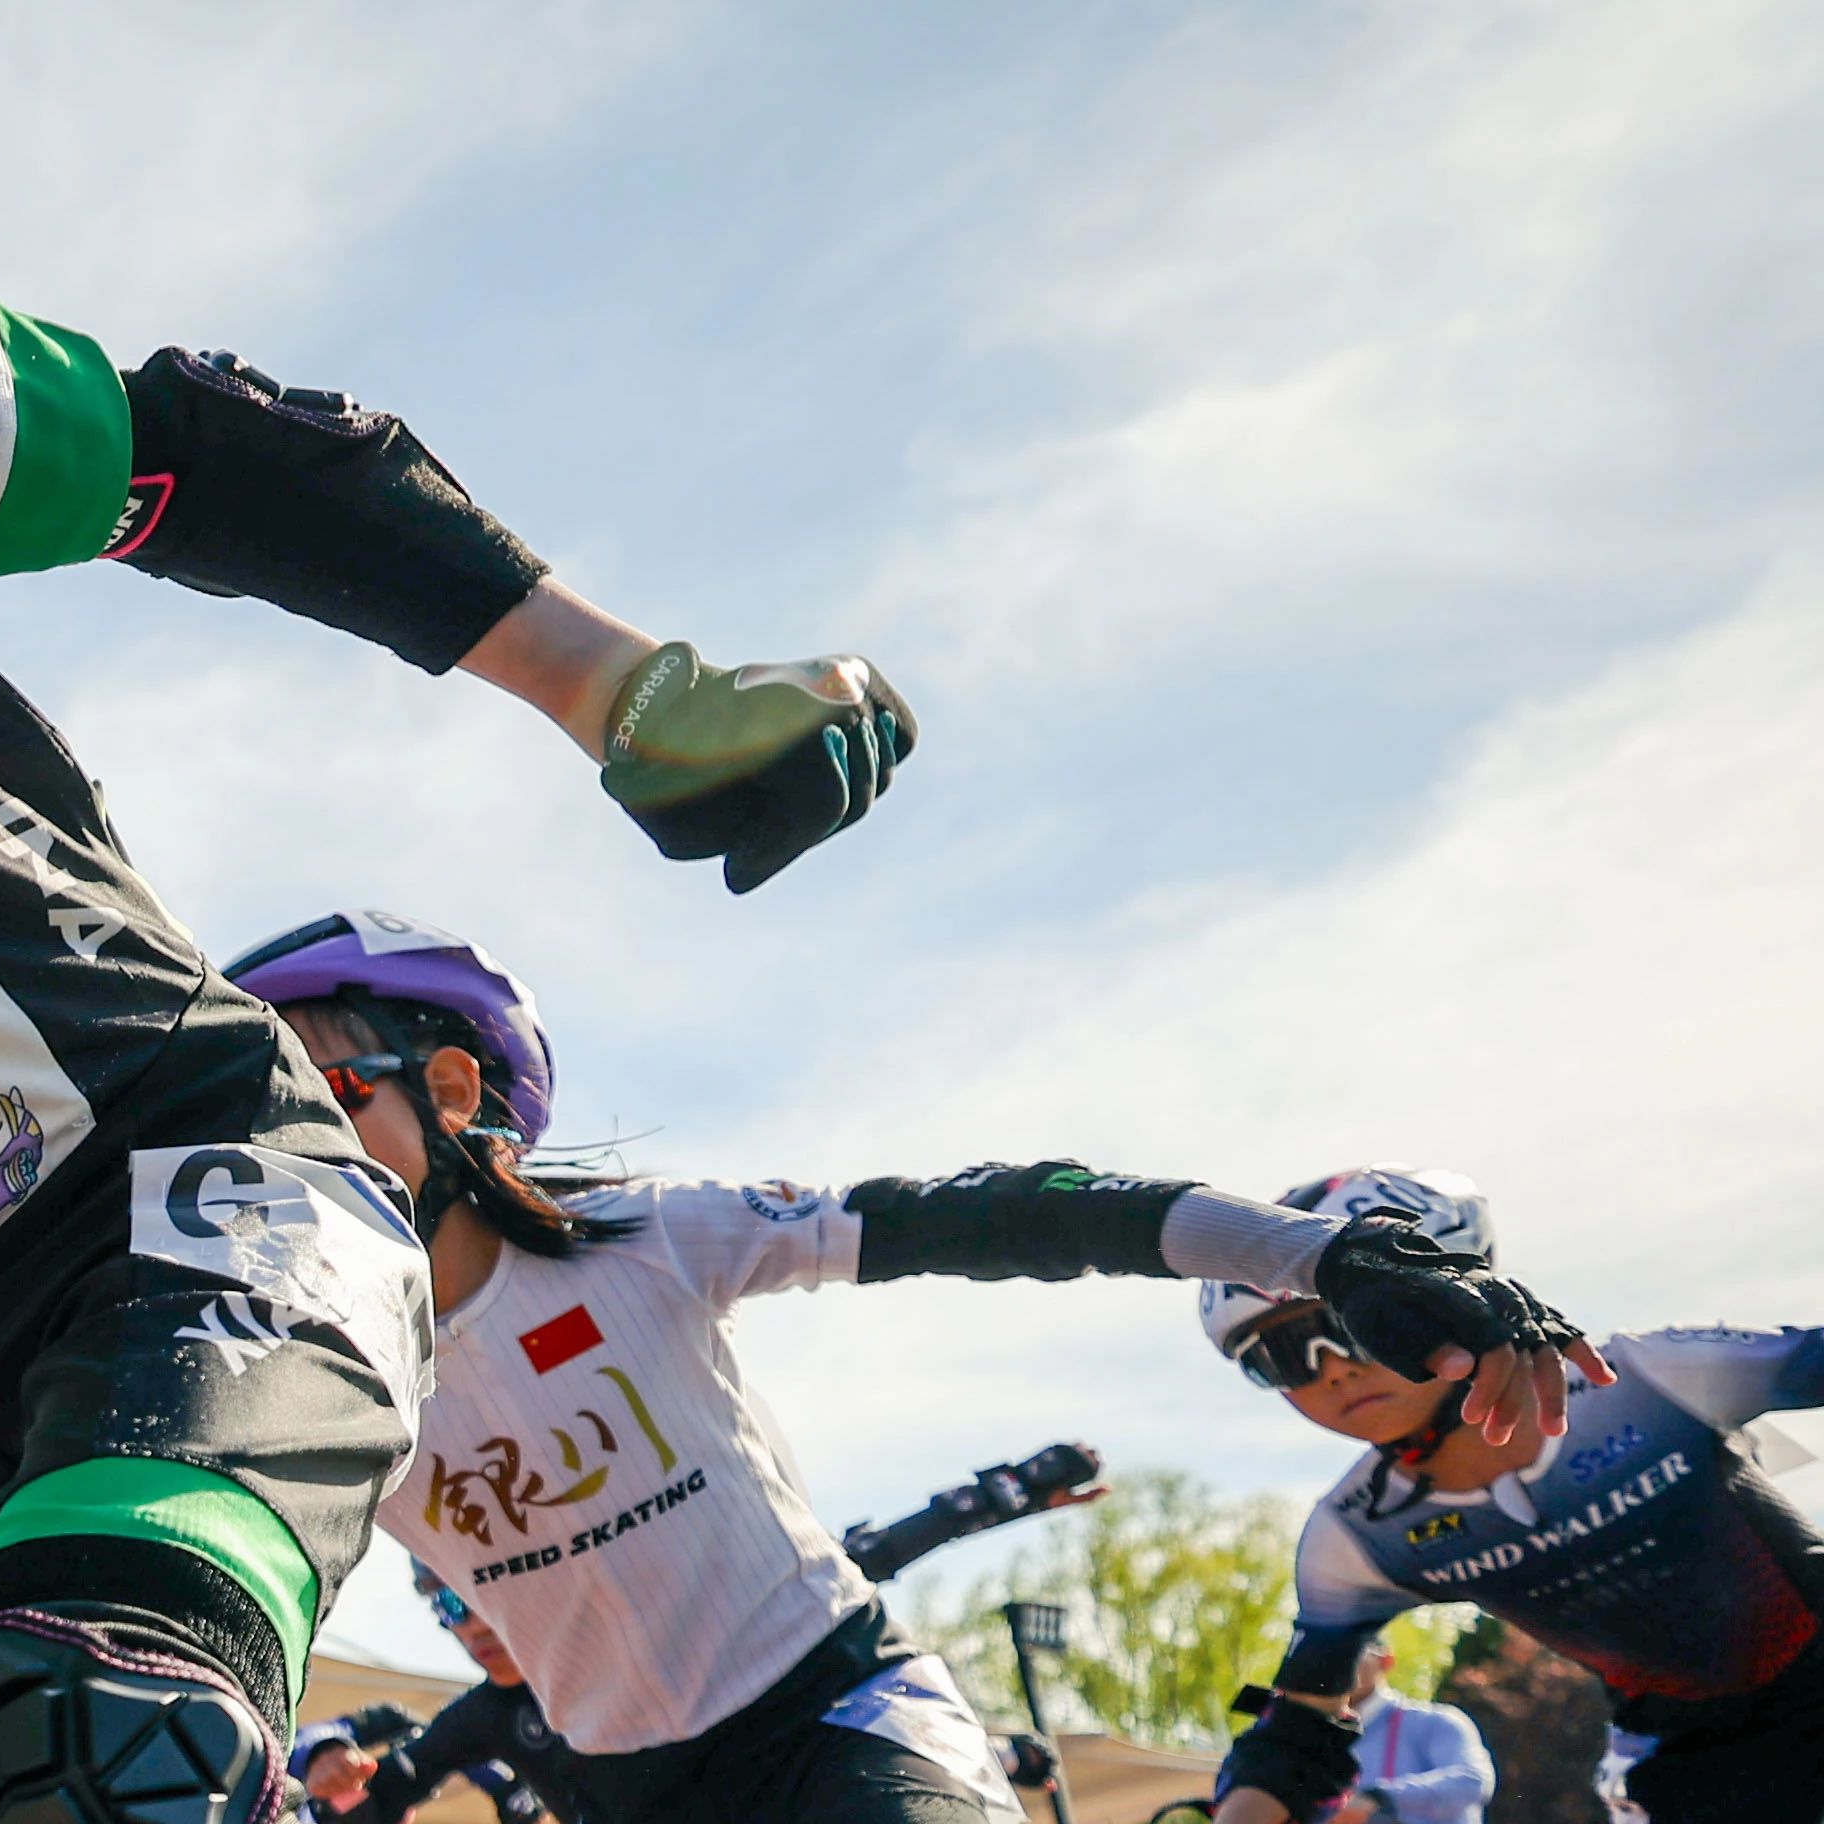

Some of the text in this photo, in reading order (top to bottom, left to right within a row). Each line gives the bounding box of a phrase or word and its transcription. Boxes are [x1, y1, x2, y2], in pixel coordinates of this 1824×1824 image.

[612, 655, 681, 751] CARAPACE
[473, 1468, 708, 1586] SPEED SKATING
[1422, 1543, 1525, 1585] WIND
[1527, 1452, 1693, 1552] WALKER
